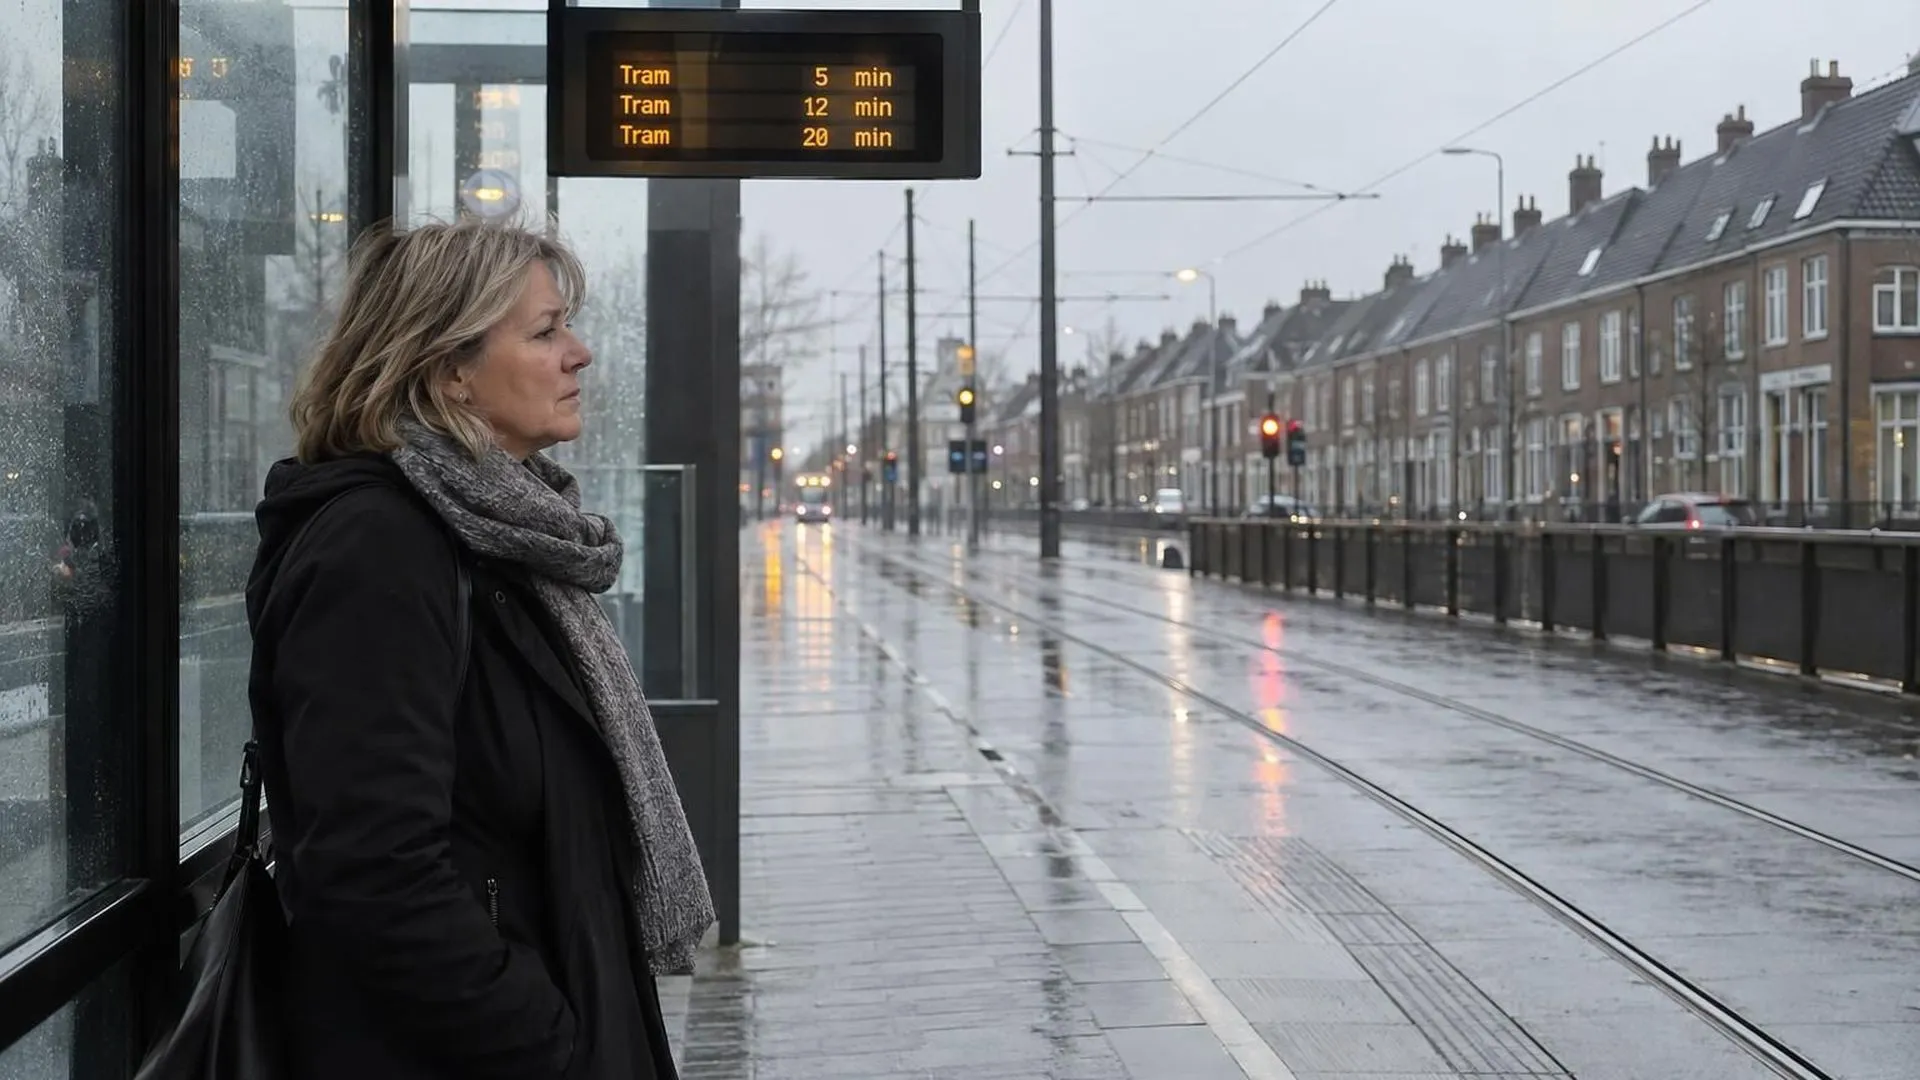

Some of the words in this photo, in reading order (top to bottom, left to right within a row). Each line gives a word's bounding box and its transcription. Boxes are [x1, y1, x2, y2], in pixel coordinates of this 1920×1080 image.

[619, 65, 670, 85] Tram
[815, 67, 829, 87] 5
[854, 67, 892, 87] min
[619, 95, 670, 115] Tram
[803, 97, 829, 117] 12
[854, 97, 892, 117] min
[619, 125, 670, 145] Tram
[802, 127, 829, 147] 20
[854, 127, 892, 147] min
